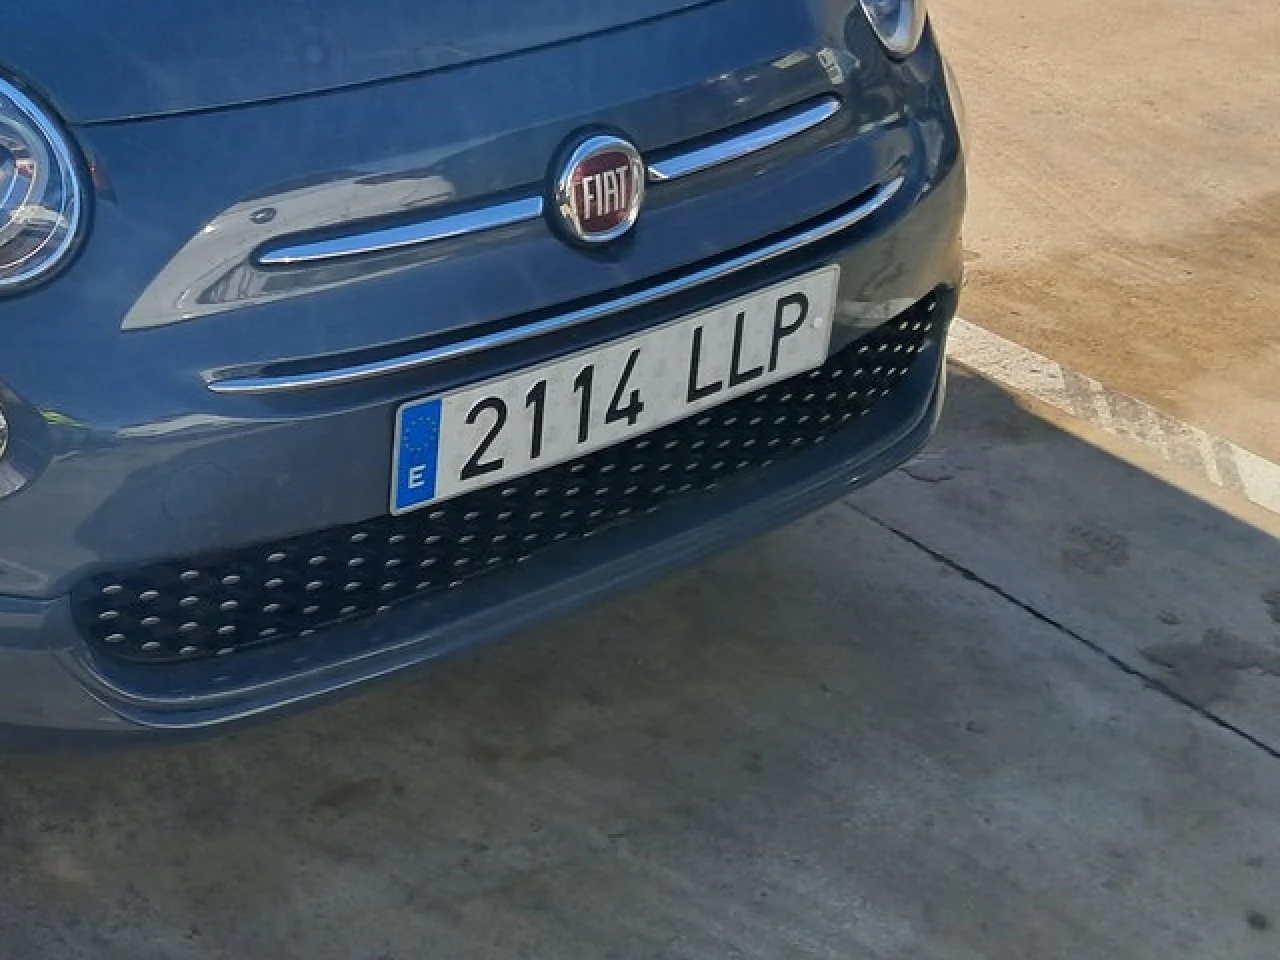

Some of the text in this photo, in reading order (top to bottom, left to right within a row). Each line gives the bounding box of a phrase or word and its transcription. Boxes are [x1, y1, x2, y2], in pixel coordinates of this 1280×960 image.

[581, 165, 629, 221] FIAT
[459, 291, 809, 481] 2114 LLP
[407, 463, 427, 490] E
